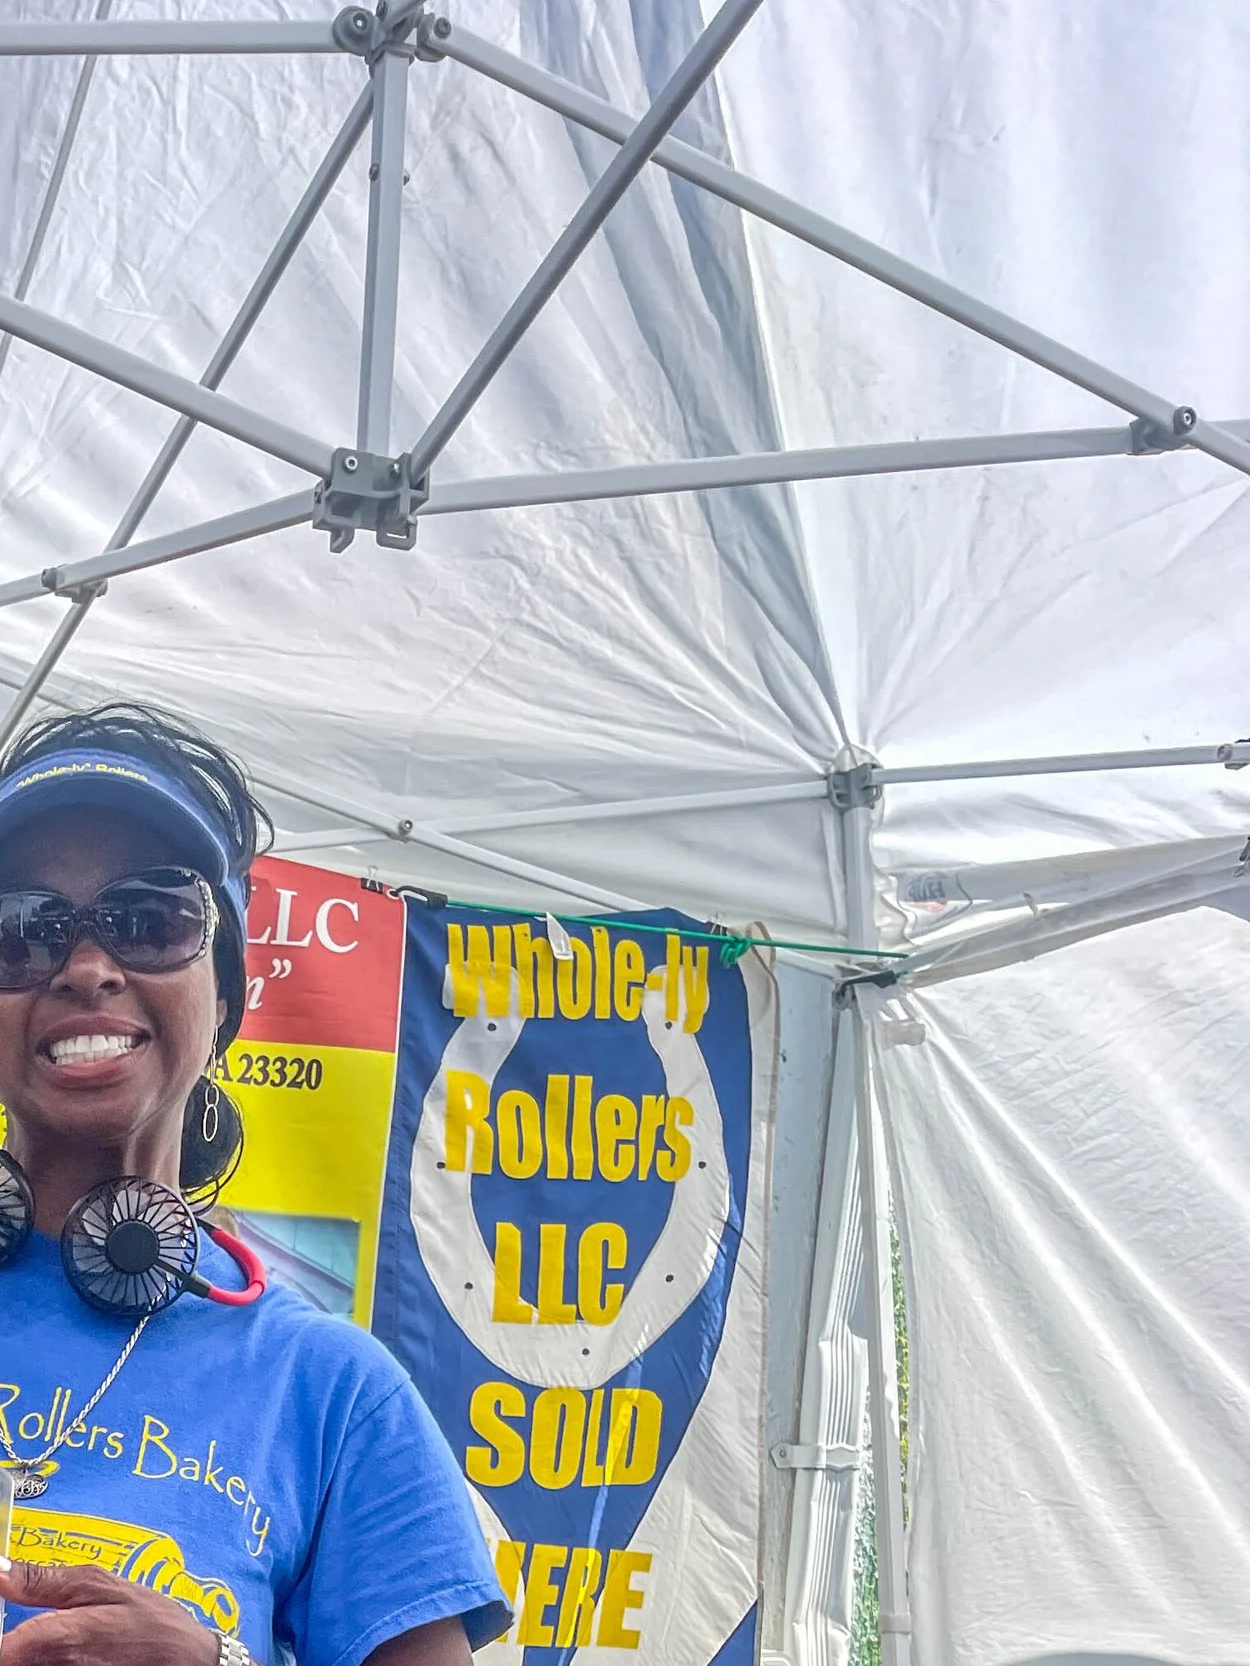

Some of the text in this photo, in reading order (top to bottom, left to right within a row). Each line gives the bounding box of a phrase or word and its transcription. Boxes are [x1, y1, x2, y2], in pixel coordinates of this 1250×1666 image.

[447, 921, 709, 1033] Whole-ly
[236, 1053, 323, 1090] 23320
[444, 1069, 694, 1182] Rollers
[492, 1222, 627, 1326] LLC
[132, 1415, 270, 1557] Bakery
[465, 1381, 663, 1490] SOLD
[17, 1526, 102, 1560] Bakery
